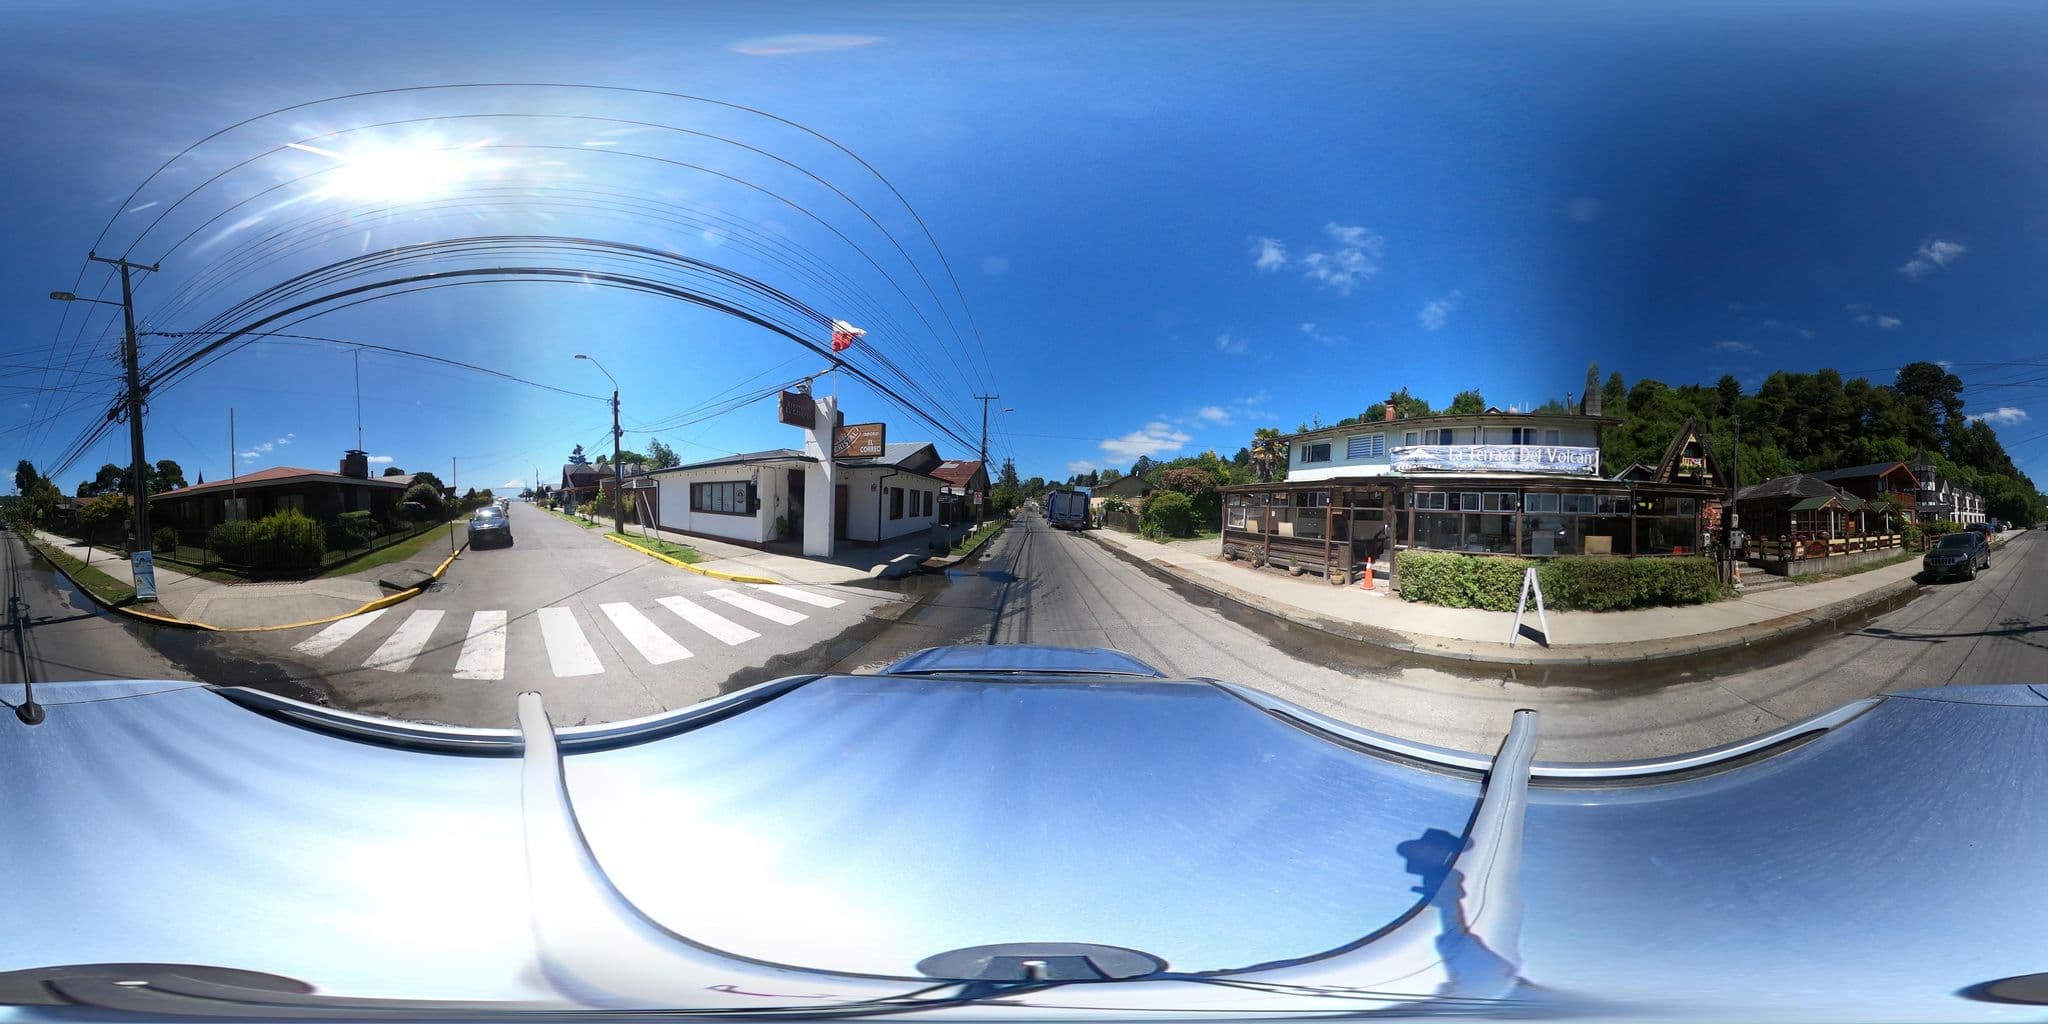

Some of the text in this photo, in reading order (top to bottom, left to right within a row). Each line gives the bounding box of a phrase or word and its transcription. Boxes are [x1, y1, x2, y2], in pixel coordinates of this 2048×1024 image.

[1448, 447, 1593, 465] La Terraza Del Volcan
